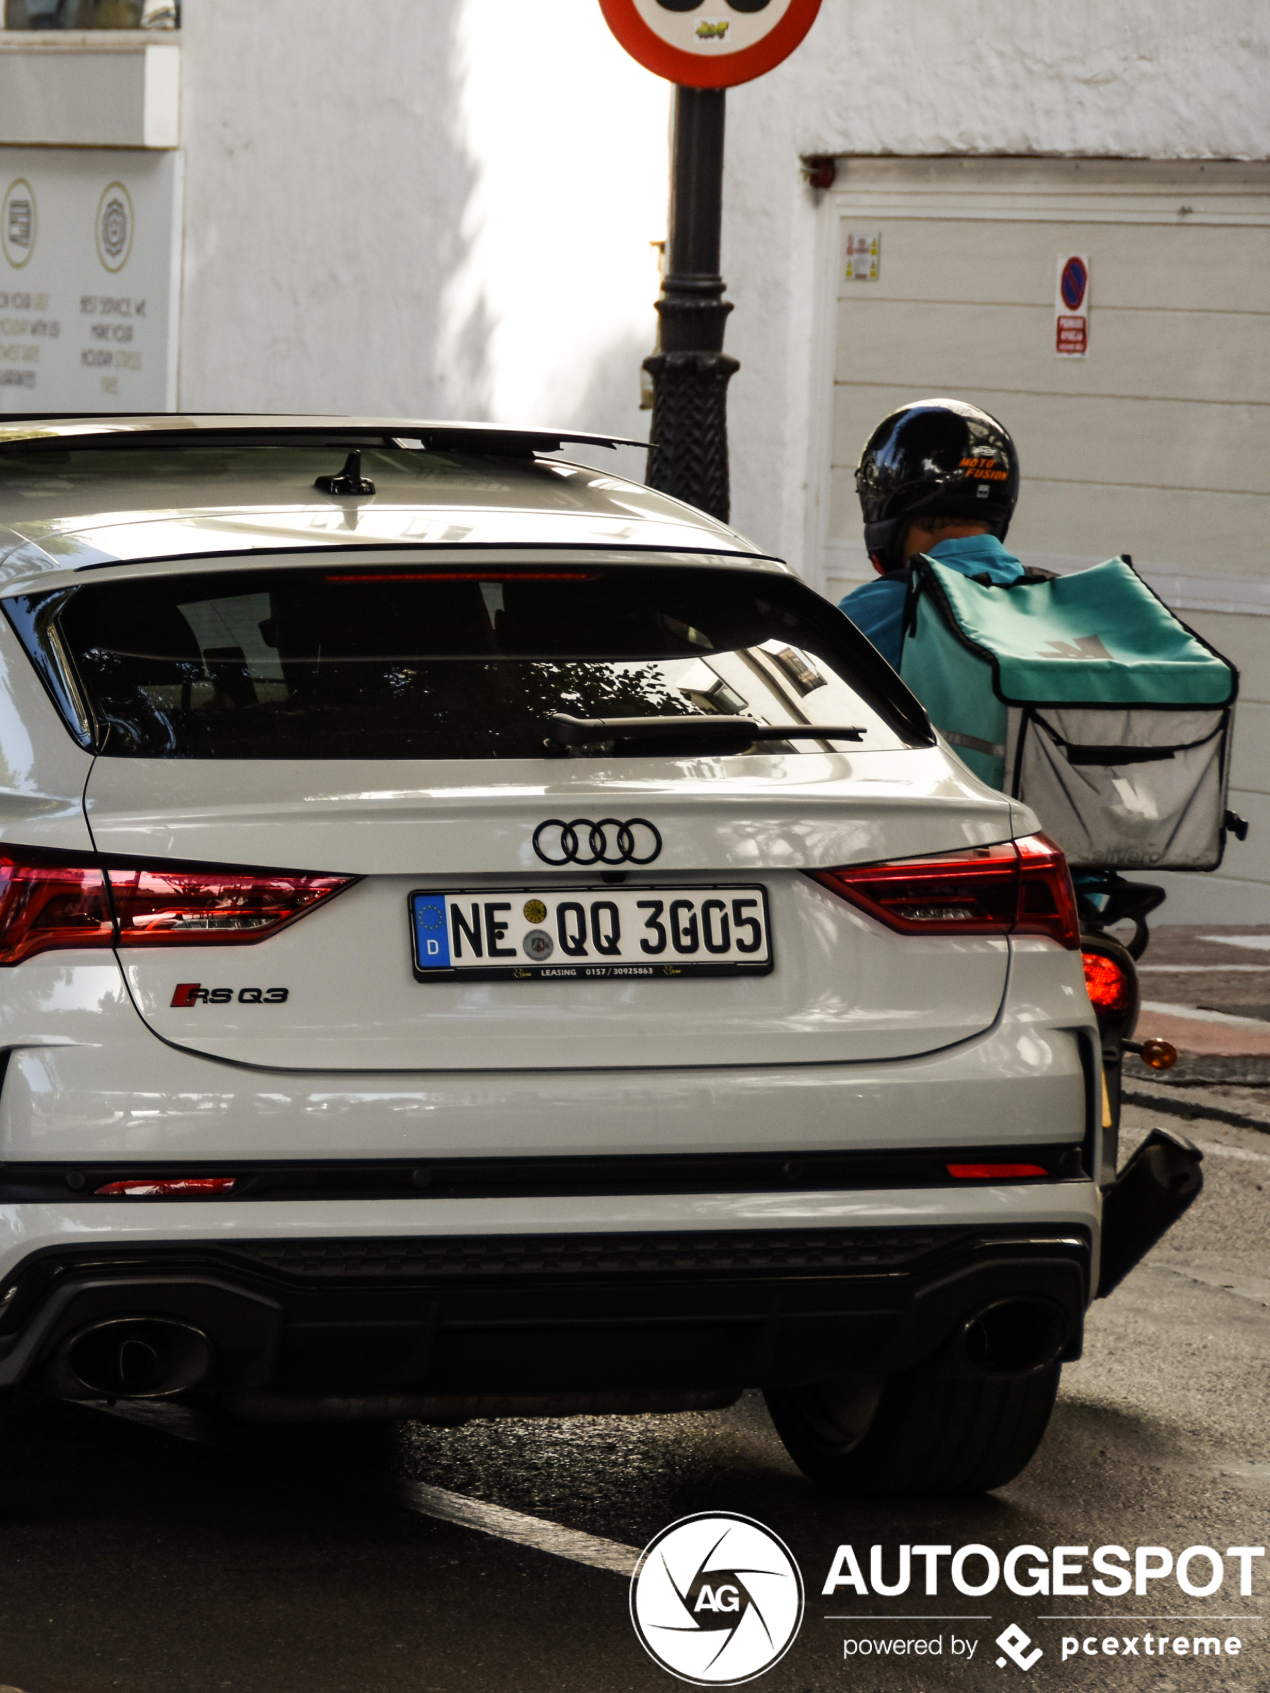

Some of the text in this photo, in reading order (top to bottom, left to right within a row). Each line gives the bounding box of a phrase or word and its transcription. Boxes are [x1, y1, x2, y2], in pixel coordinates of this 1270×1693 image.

[959, 458, 996, 468] MOTO
[965, 468, 1008, 481] FUSION
[450, 902, 517, 958] NE
[556, 900, 622, 957] QQ
[636, 898, 762, 955] 3005
[427, 939, 439, 955] D
[541, 969, 577, 977] LEASING
[183, 986, 289, 1004] RS Q3
